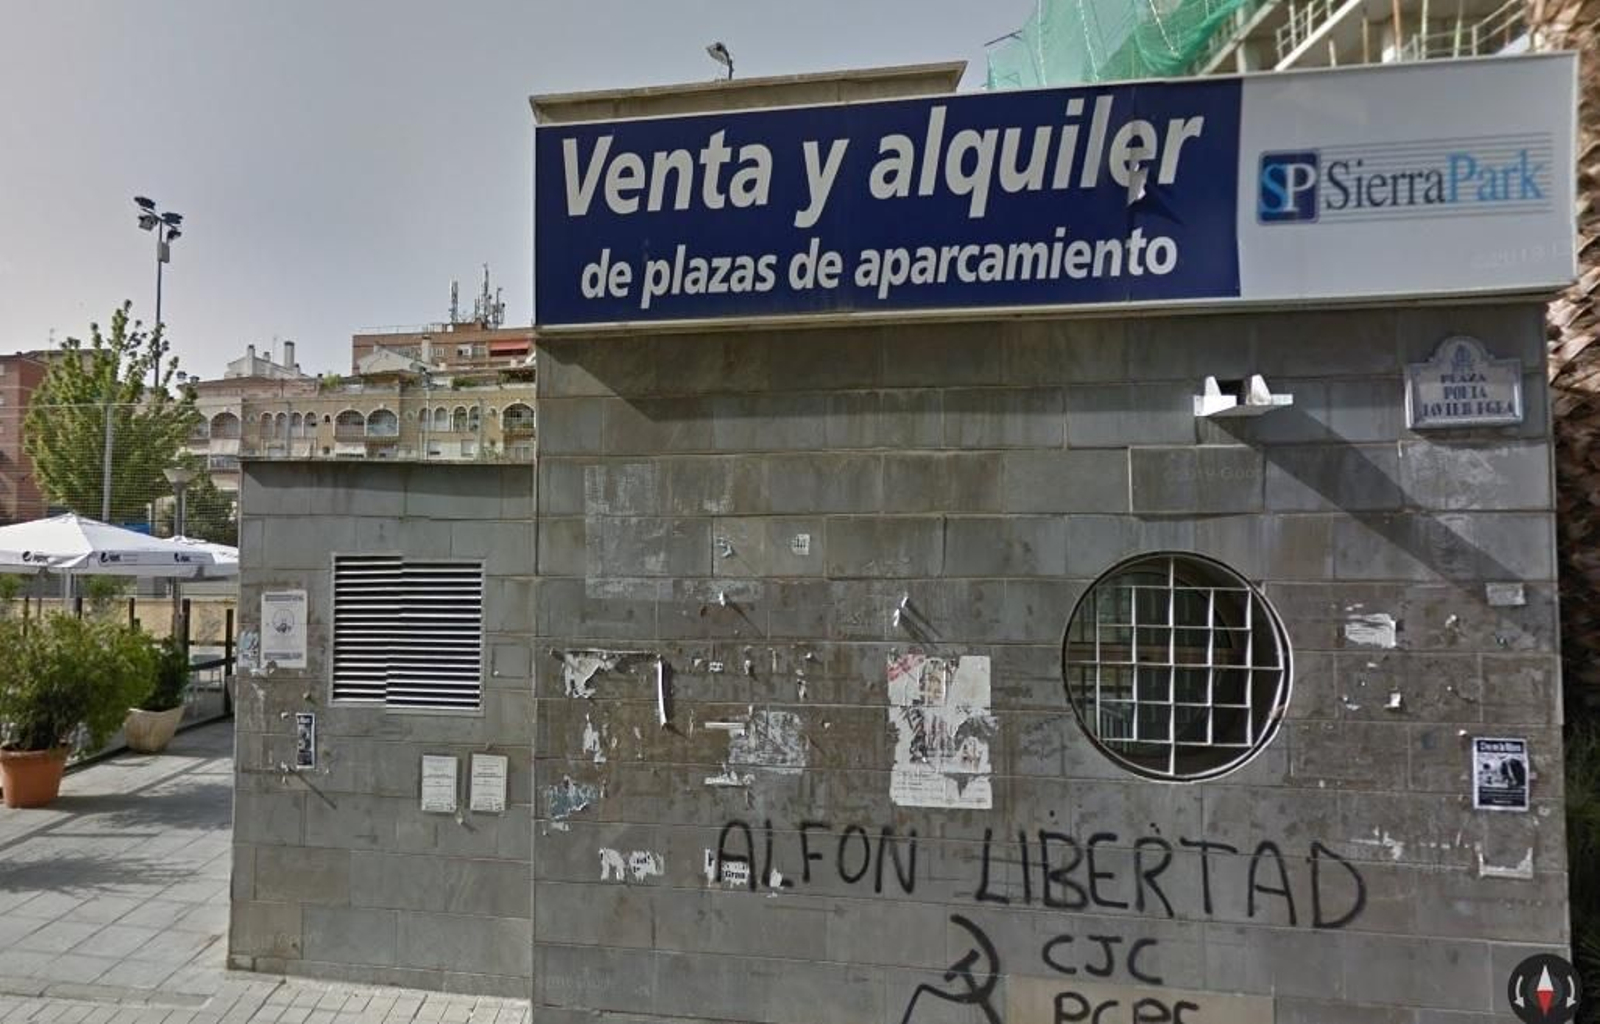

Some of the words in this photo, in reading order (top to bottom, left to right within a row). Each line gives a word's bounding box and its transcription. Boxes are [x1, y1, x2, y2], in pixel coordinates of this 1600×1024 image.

[562, 130, 773, 217] Venta
[793, 138, 849, 228] y
[868, 96, 1205, 219] alquiler
[1260, 162, 1316, 213] SP
[580, 248, 632, 299] de
[640, 244, 777, 309] plazas
[788, 237, 843, 291] de
[854, 227, 1178, 300] aparcamiento
[715, 820, 917, 893] ALFON
[976, 828, 1368, 930] LIBERTAD
[1041, 934, 1164, 986] CJC
